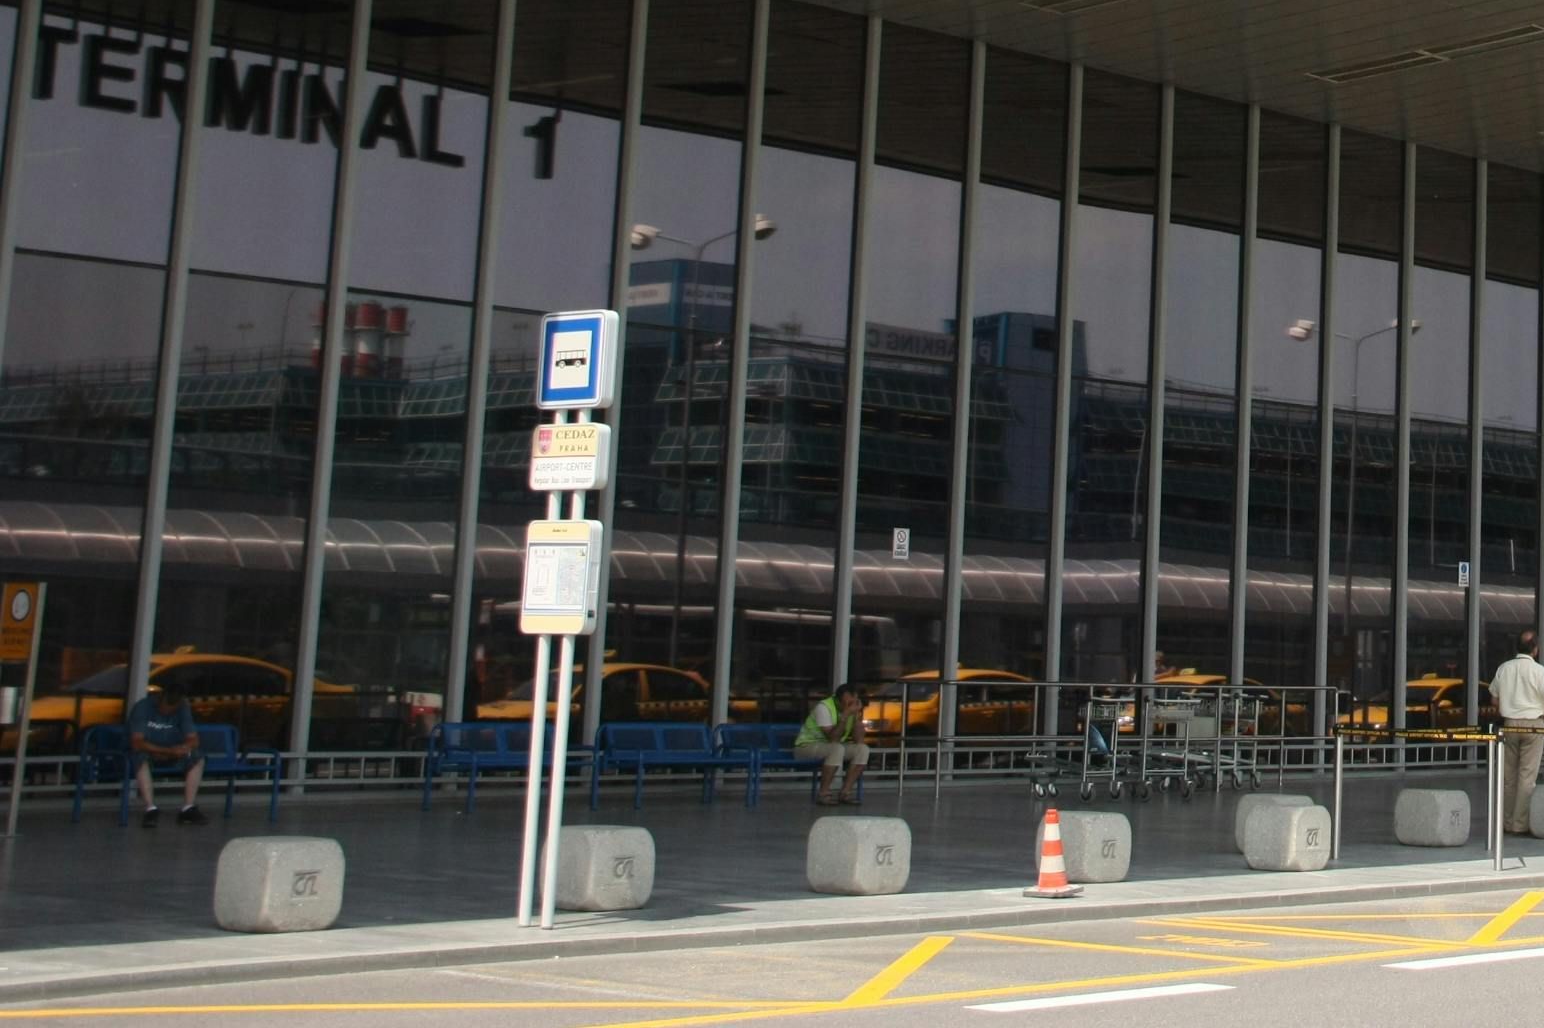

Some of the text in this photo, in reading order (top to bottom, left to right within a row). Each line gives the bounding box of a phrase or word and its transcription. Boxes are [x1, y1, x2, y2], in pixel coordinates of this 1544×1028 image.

[32, 24, 557, 180] TERMINAL 1
[555, 429, 596, 439] CEDAZ
[559, 444, 589, 452] PRAHA
